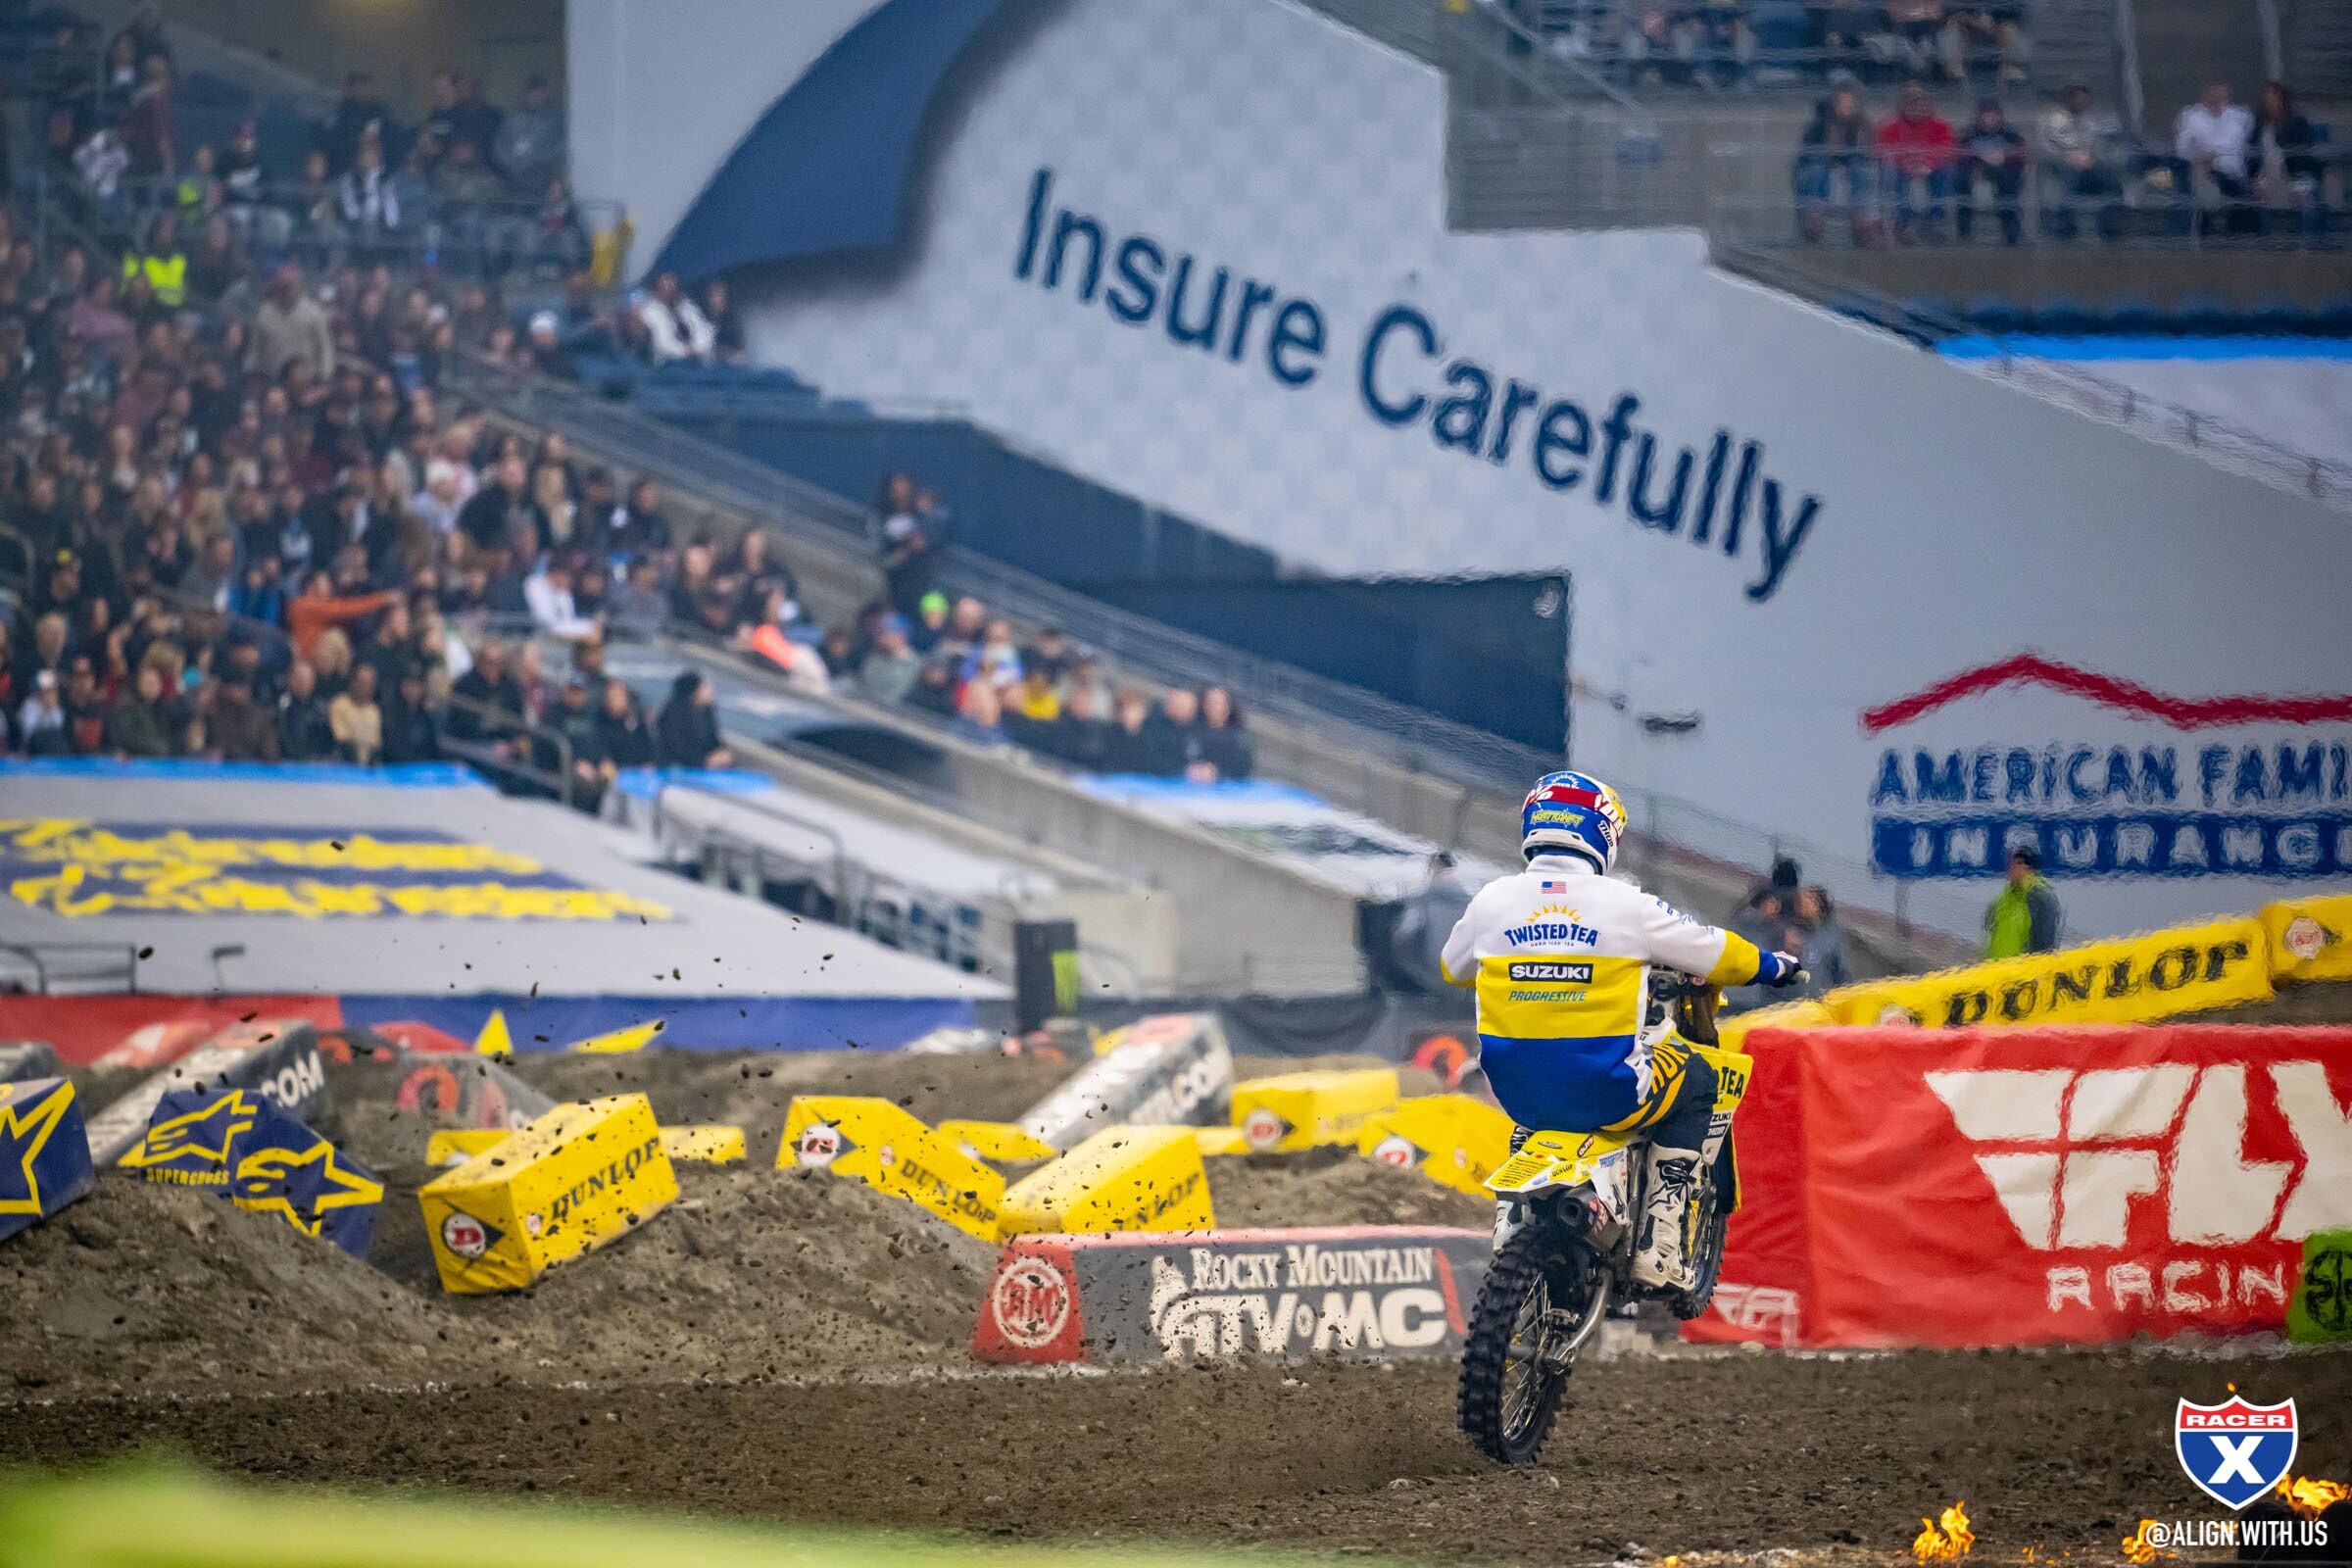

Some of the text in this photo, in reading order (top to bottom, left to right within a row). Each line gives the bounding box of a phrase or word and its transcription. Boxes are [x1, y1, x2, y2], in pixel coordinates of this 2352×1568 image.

[1014, 167, 1823, 602] Insure Carefully
[1871, 745, 2178, 805] AMERICAN
[1504, 923, 1598, 947] TWISTED TEA
[1508, 990, 1587, 1002] PROGRESSIVE
[1511, 964, 1590, 979] SUZUKI
[1945, 941, 2250, 1025] DUNLOP
[1639, 1044, 1690, 1105] HOR
[1721, 1066, 1744, 1099] TEA
[1711, 1112, 1732, 1123] ZUKI
[147, 1167, 229, 1185] SUPERCROSS
[551, 1137, 660, 1221] DUNLOP
[1552, 1163, 1573, 1177] DUNLOP
[1924, 1060, 2352, 1250] FLY
[900, 1159, 997, 1222] DUNLOP
[1191, 1245, 1436, 1291] ROCKY MOUNTAIN
[2045, 1260, 2298, 1313] RACIN
